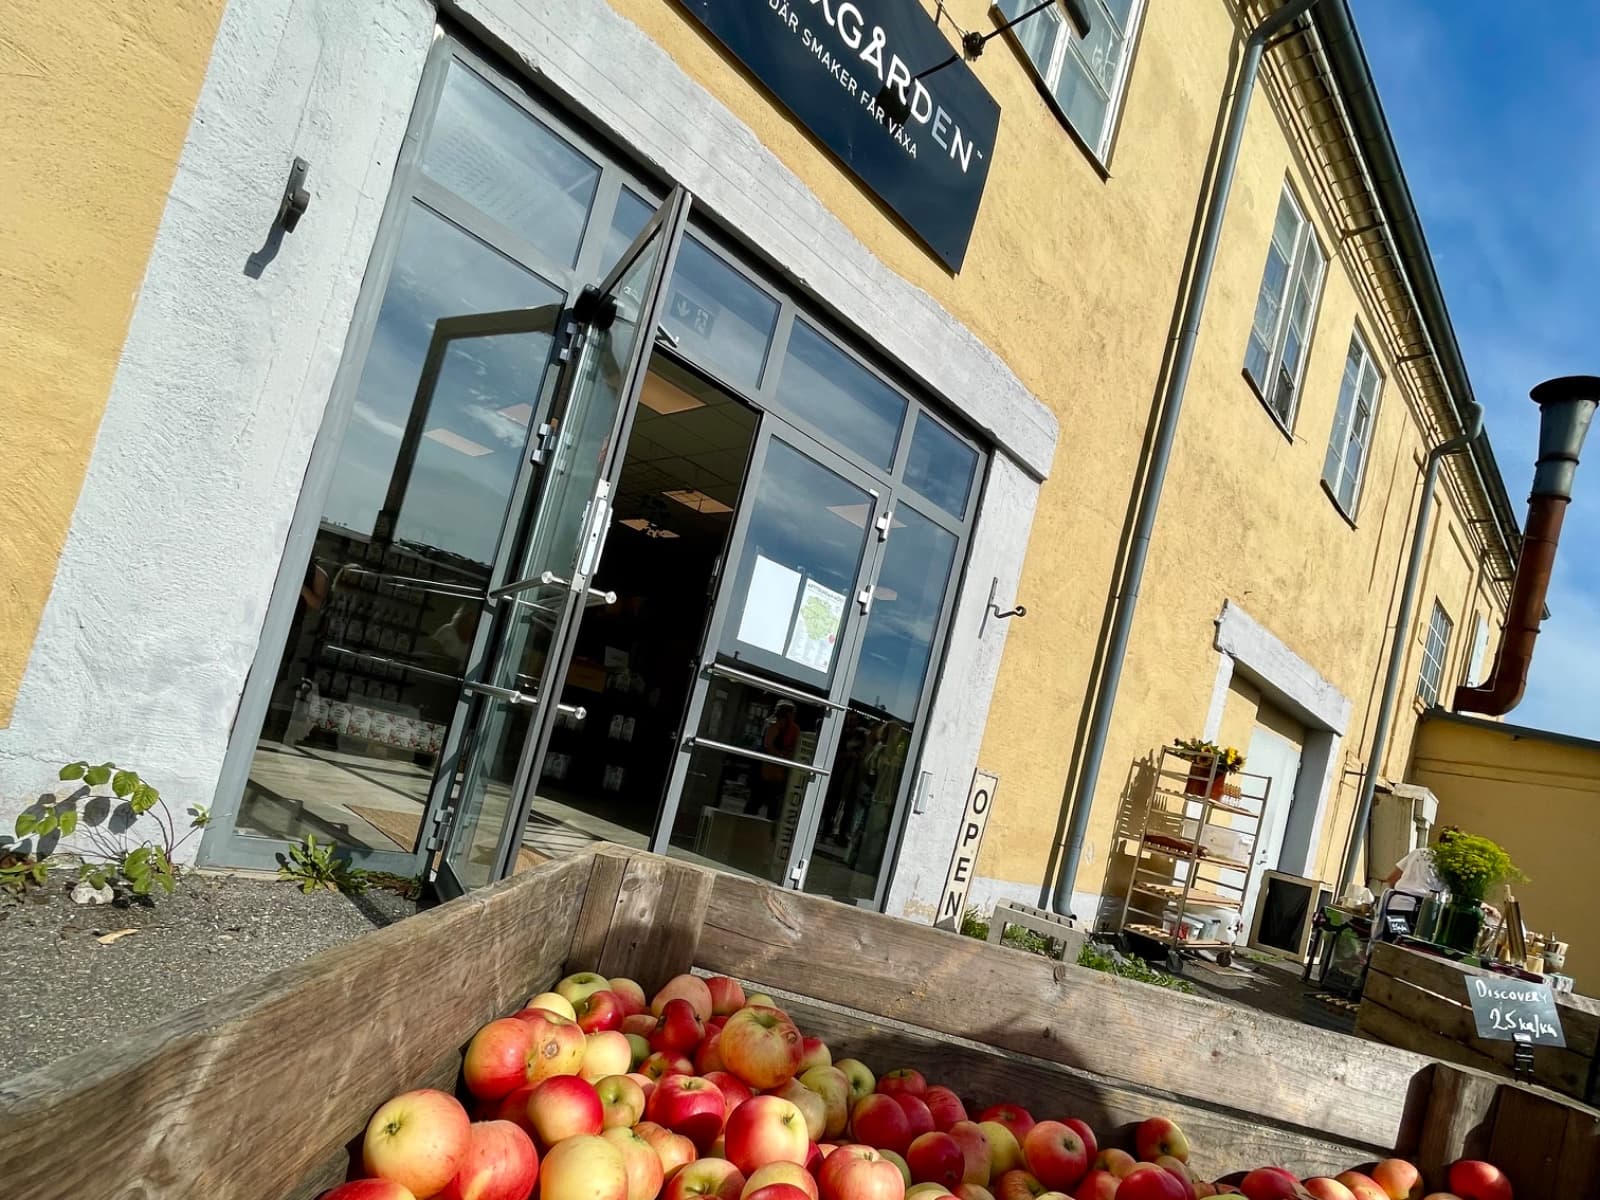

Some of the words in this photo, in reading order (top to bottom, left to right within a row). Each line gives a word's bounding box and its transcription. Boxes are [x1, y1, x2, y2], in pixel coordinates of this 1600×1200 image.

[801, 27, 858, 97] SMAKER
[860, 90, 885, 125] FÅR
[888, 117, 917, 159] VÄXA
[944, 789, 989, 917] OPEN
[1489, 1007, 1517, 1031] 25
